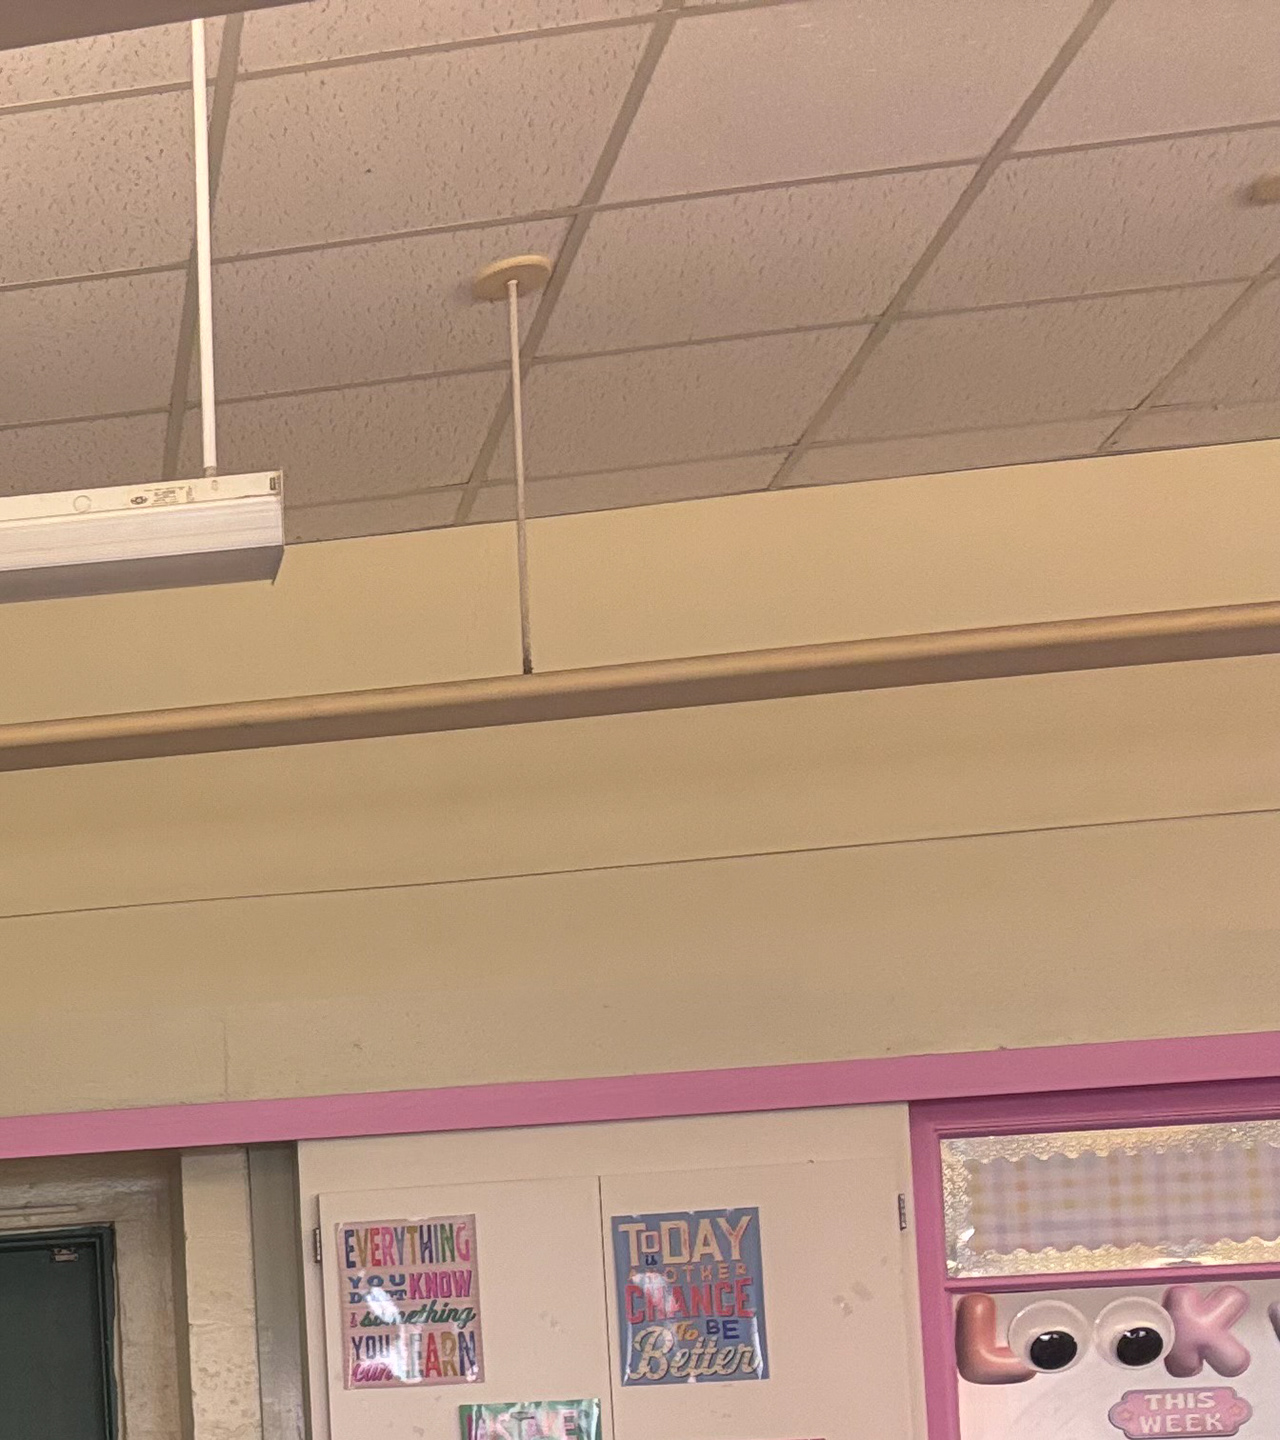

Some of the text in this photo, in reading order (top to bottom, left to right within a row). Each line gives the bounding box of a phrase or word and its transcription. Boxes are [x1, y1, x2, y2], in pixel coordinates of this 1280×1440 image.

[344, 1222, 472, 1269] EVERYTHING
[618, 1215, 753, 1267] TODAY
[348, 1273, 406, 1290] YOU
[409, 1270, 473, 1300] KNOW
[625, 1277, 756, 1325] CHANCE
[706, 1318, 740, 1340] BE
[351, 1334, 391, 1361] YOU
[629, 1325, 763, 1382] Better
[1144, 1391, 1216, 1411] THIS
[1139, 1412, 1224, 1434] WEEK
